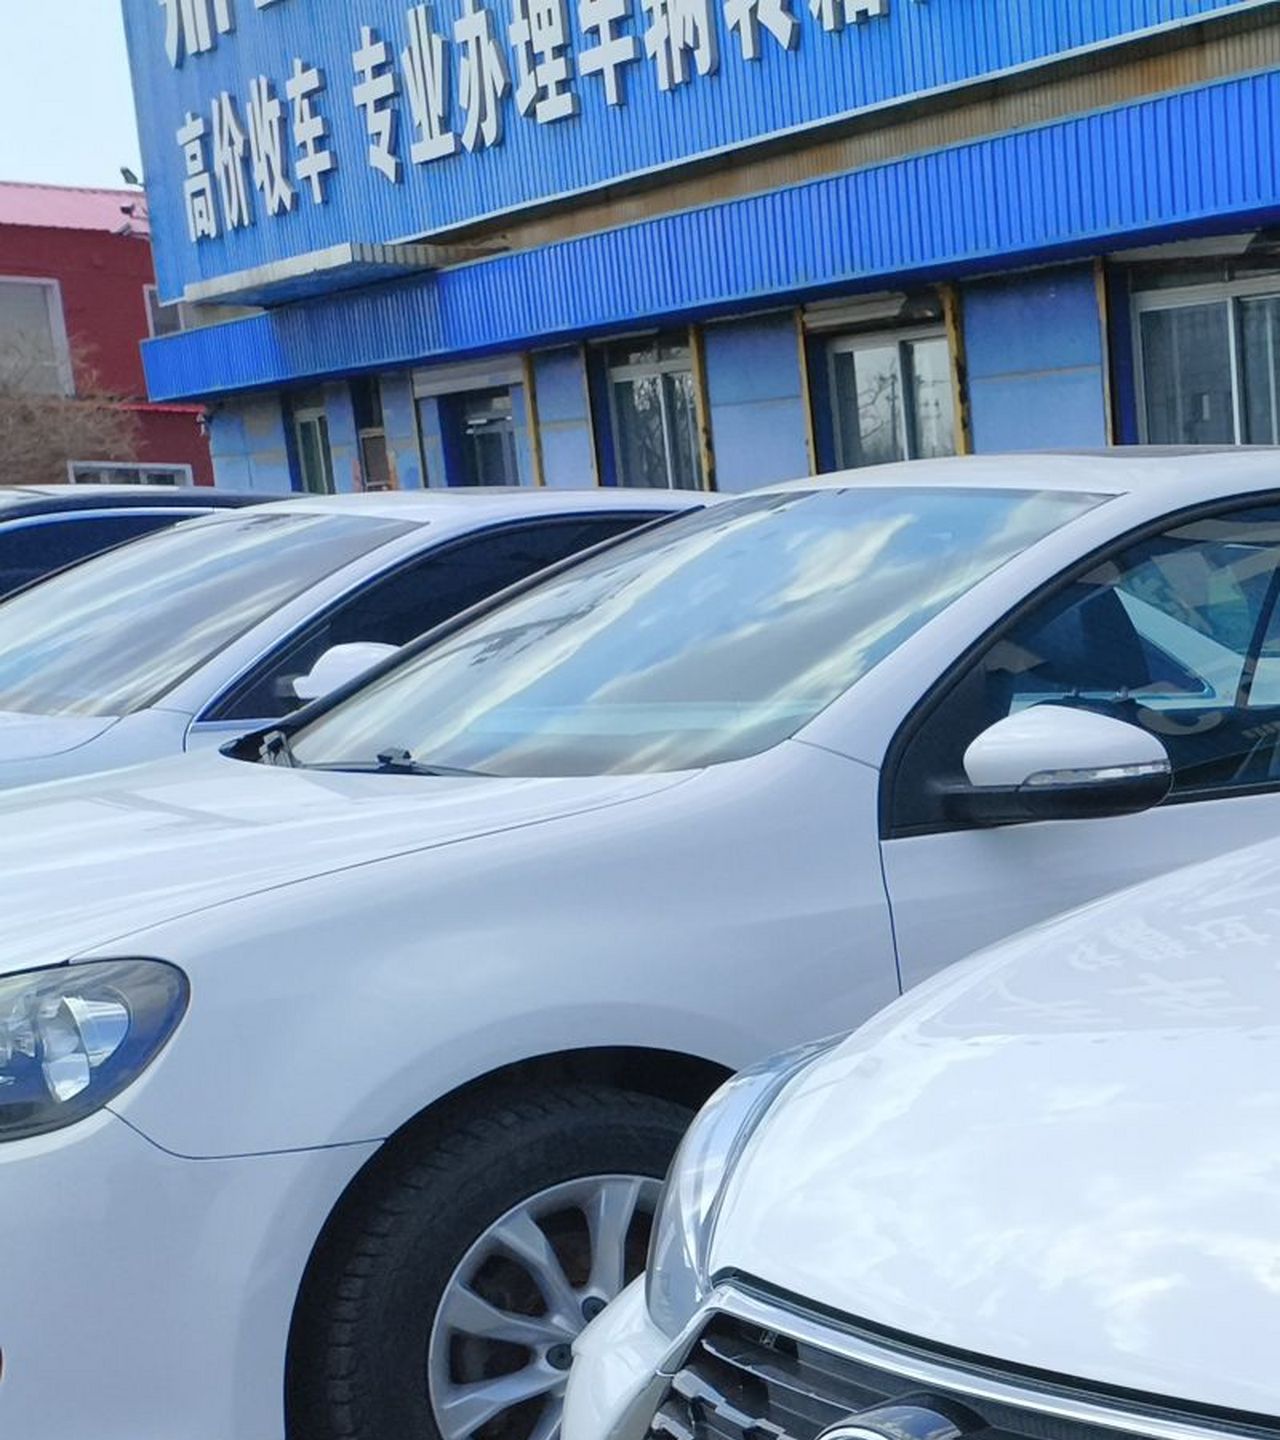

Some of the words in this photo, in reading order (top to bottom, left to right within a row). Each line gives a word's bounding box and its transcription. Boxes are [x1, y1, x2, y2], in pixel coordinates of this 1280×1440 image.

[176, 57, 337, 243] 高价收车
[352, 0, 890, 185] 专业办理车辆
